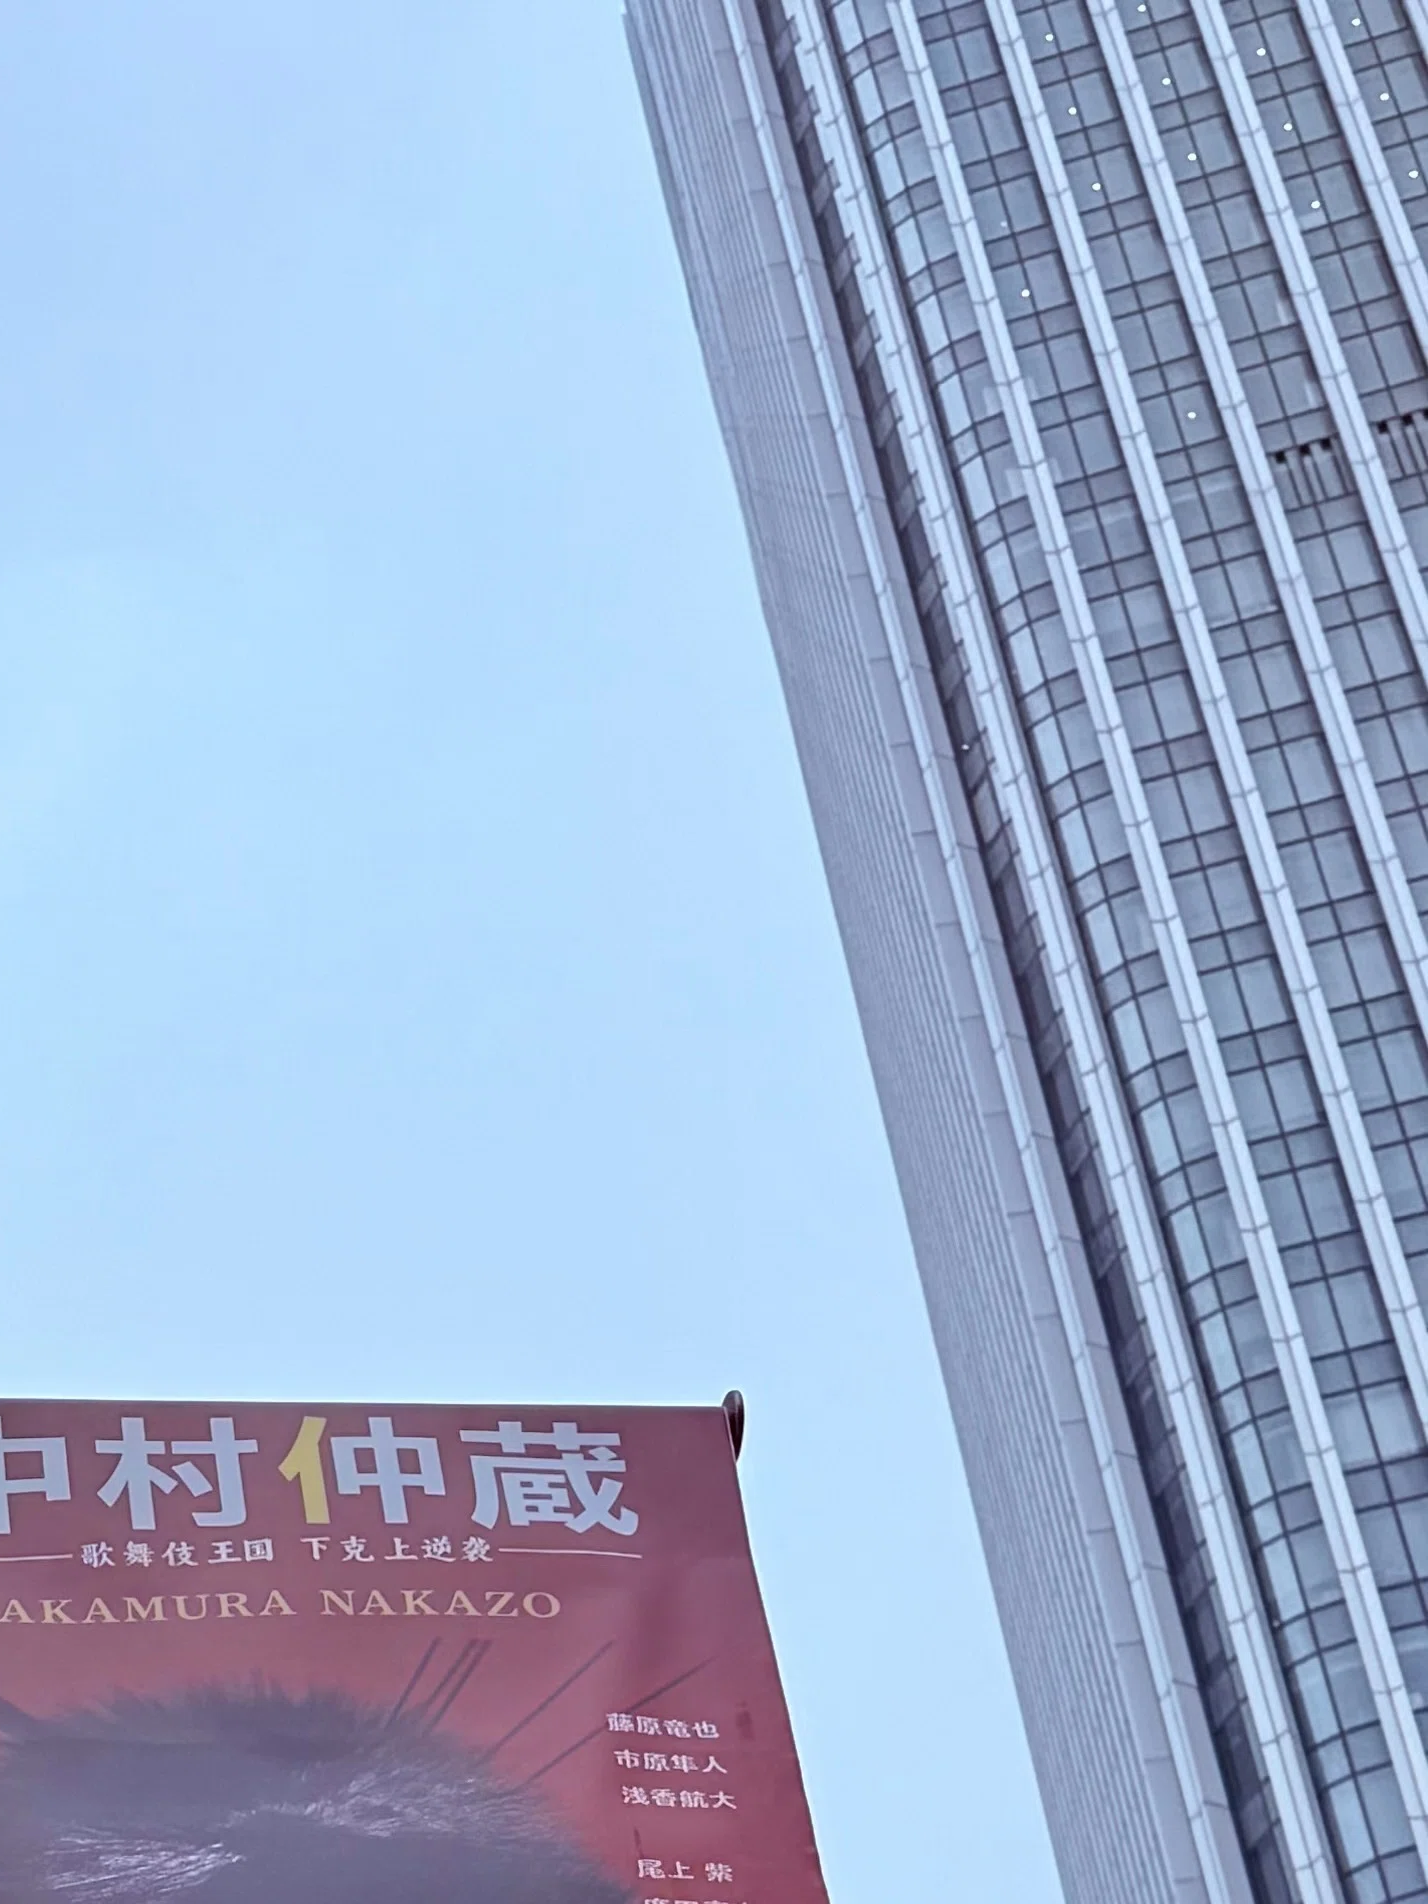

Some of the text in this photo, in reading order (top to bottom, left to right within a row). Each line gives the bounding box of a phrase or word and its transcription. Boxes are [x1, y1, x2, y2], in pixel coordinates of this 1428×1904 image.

[80, 1535, 494, 1569] 歌舞伎王国 下克上逆袭
[320, 1588, 562, 1621] NAKAZO
